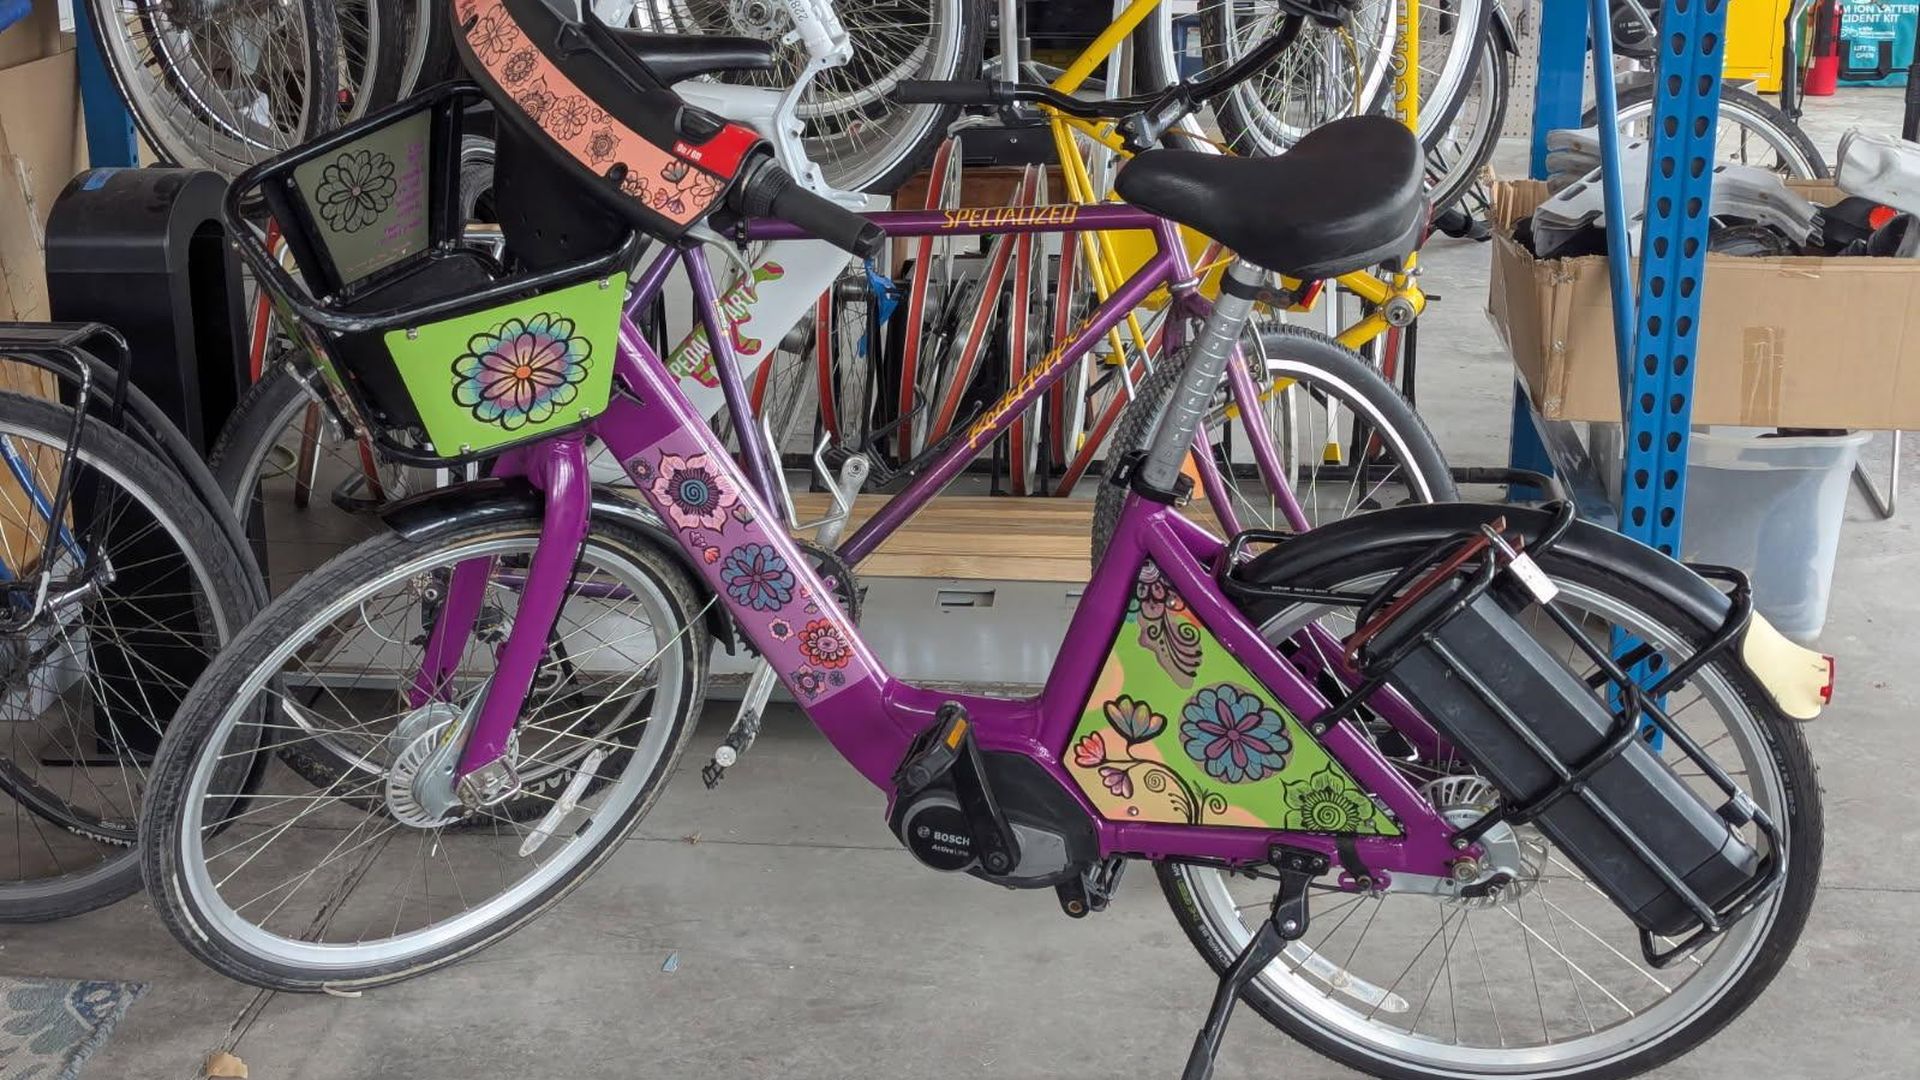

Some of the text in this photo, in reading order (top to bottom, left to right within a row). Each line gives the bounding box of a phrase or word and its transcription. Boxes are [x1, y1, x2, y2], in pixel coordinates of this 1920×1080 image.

[1854, 5, 1875, 14] ION
[1883, 14, 1900, 23] KIT
[941, 205, 1079, 228] SPECIALIZED
[934, 831, 971, 847] BOSCH
[931, 844, 954, 855] Active
